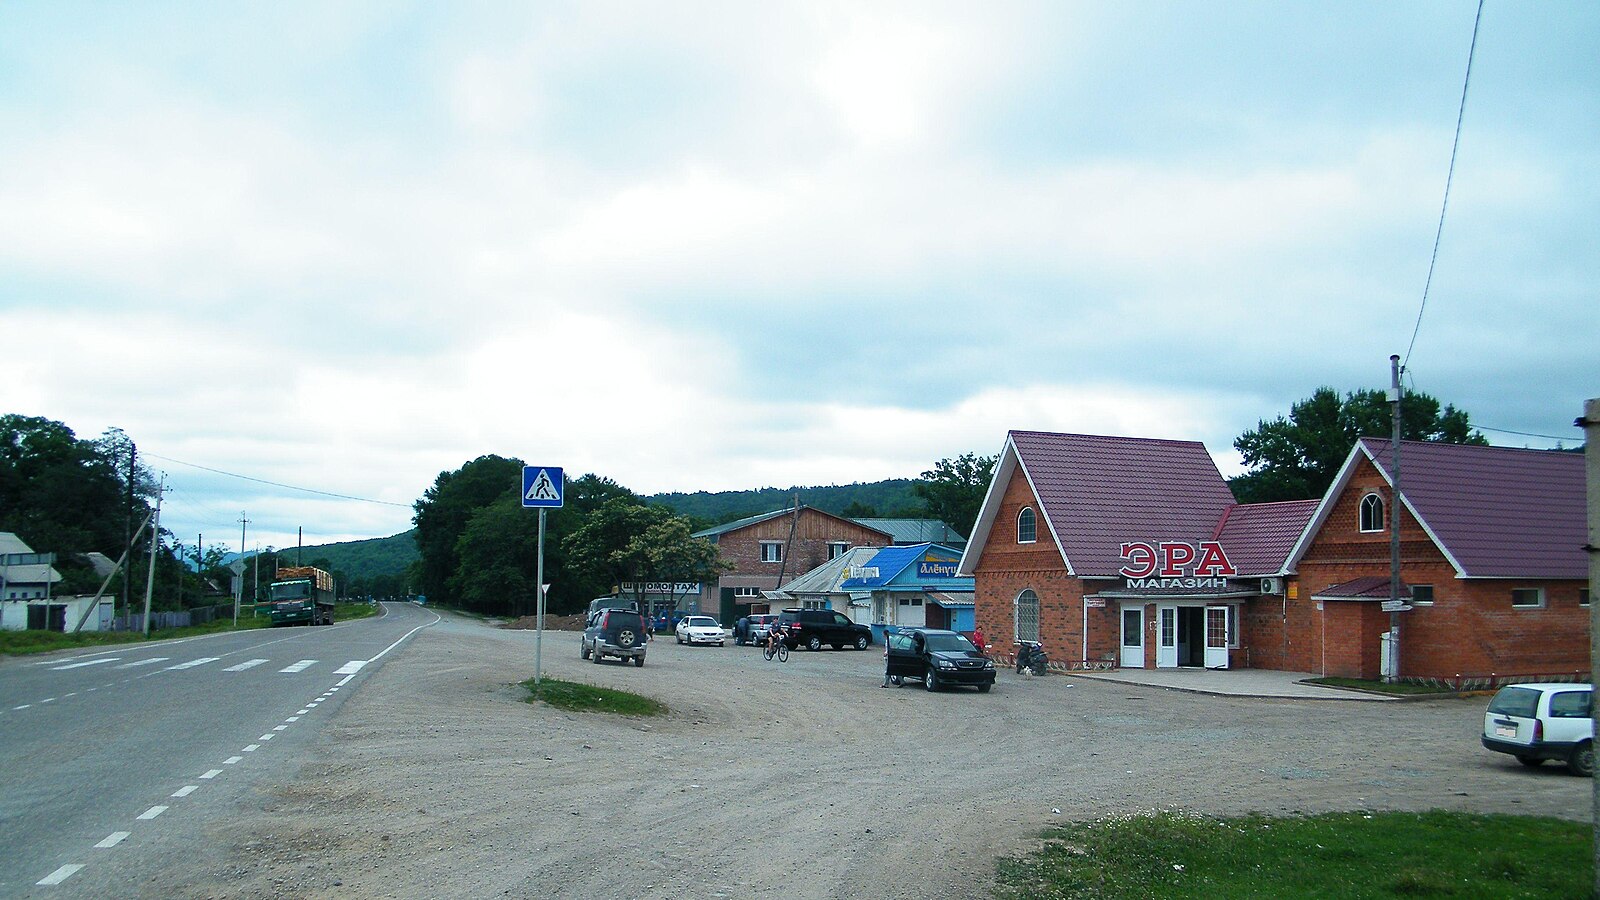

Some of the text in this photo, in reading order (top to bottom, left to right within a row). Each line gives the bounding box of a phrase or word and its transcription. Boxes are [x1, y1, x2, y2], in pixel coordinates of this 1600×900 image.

[1119, 541, 1237, 578] ЭРА
[623, 582, 697, 590] ШОМОНТАЖ
[1126, 578, 1227, 588] МАГАЗИН
